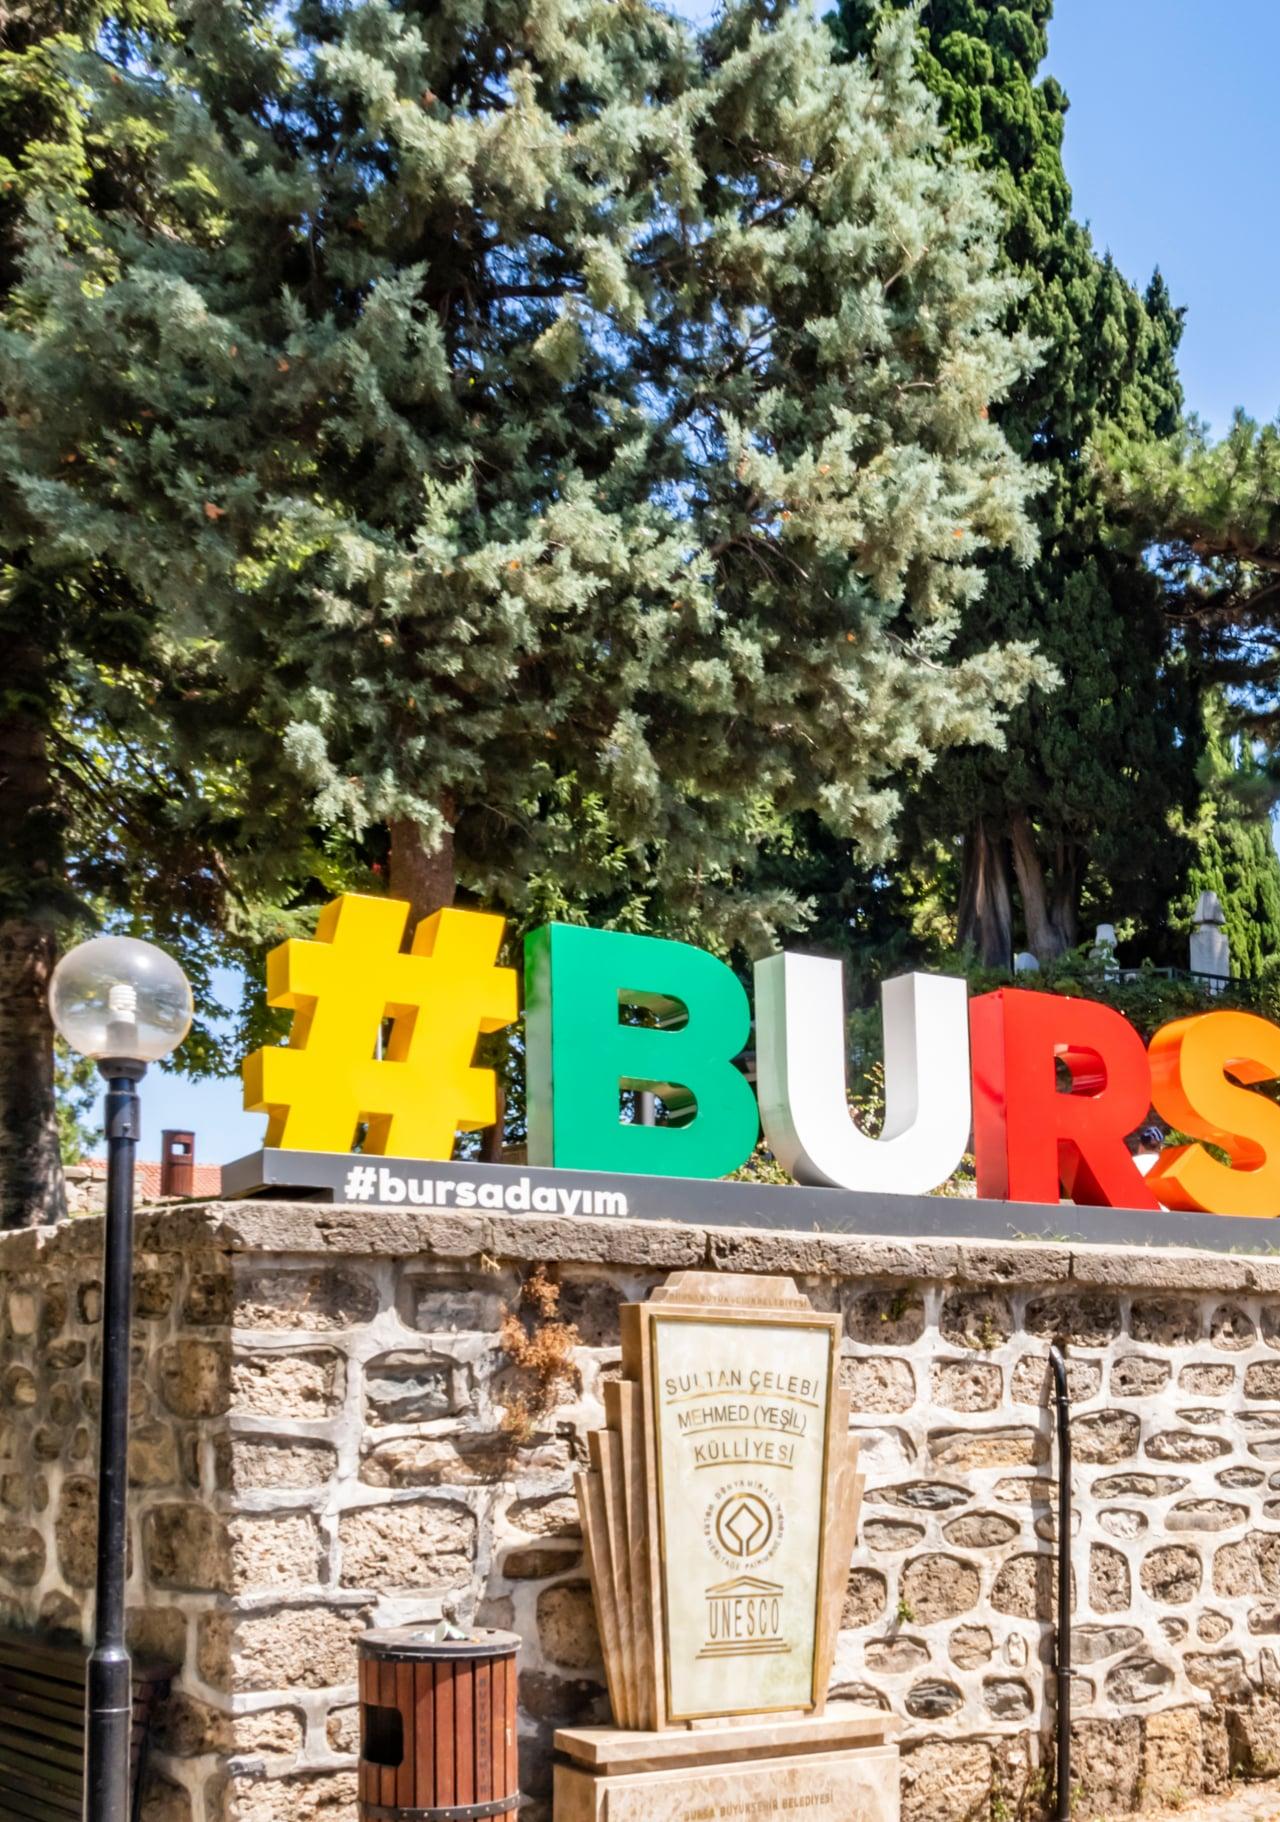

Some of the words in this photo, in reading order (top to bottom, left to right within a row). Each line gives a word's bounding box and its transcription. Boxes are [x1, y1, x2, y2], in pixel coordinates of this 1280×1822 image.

[344, 1165, 628, 1216] #bursadayım
[665, 1370, 742, 1396] SULTAN
[749, 1370, 819, 1398] ÇELEBİ
[678, 1405, 749, 1429] MEHMED
[694, 1437, 795, 1462] KÜLLİYESİ
[709, 1598, 779, 1639] UNESCO
